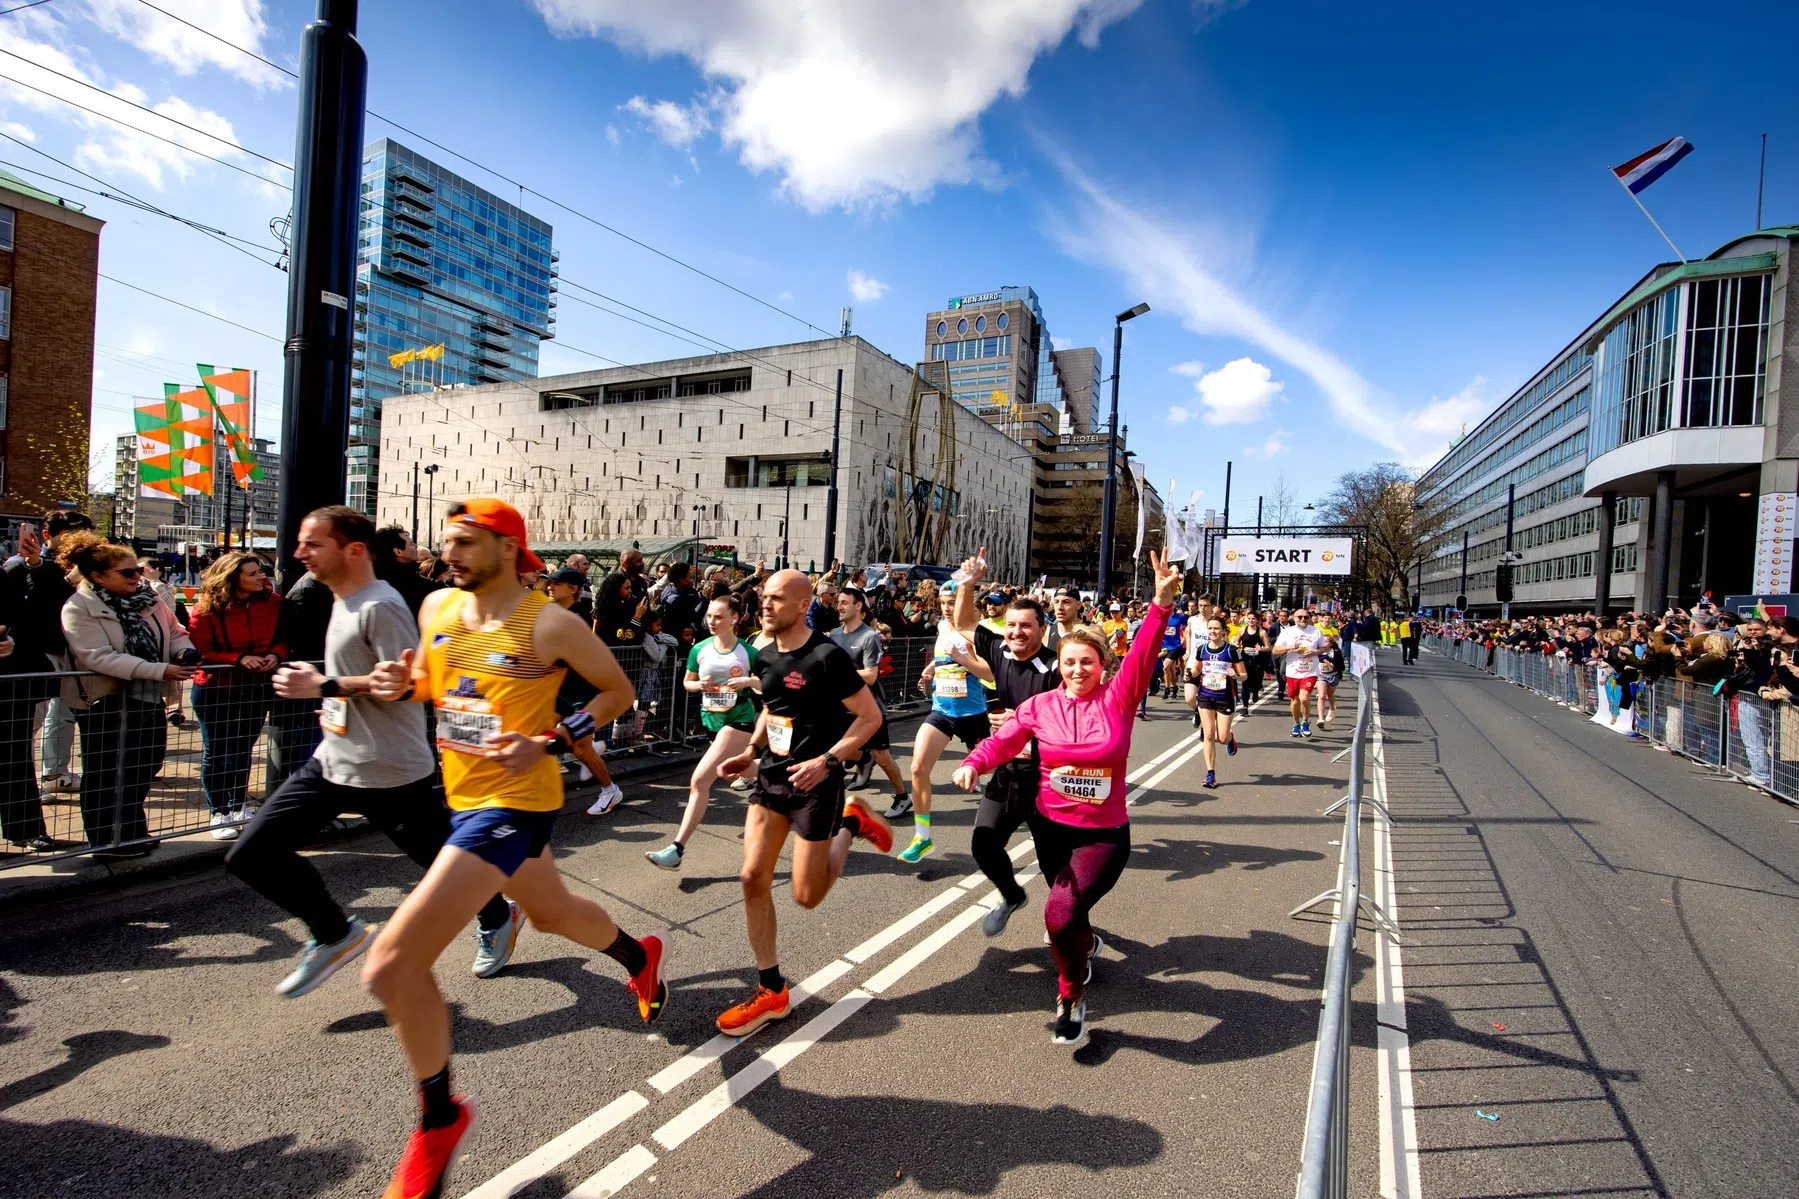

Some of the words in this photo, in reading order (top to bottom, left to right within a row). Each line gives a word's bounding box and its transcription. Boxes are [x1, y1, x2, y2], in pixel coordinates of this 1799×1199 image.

[1255, 549, 1311, 562] START
[1083, 769, 1104, 777] RUN
[1061, 777, 1102, 786] SABRIE
[1064, 786, 1096, 797] 61464
